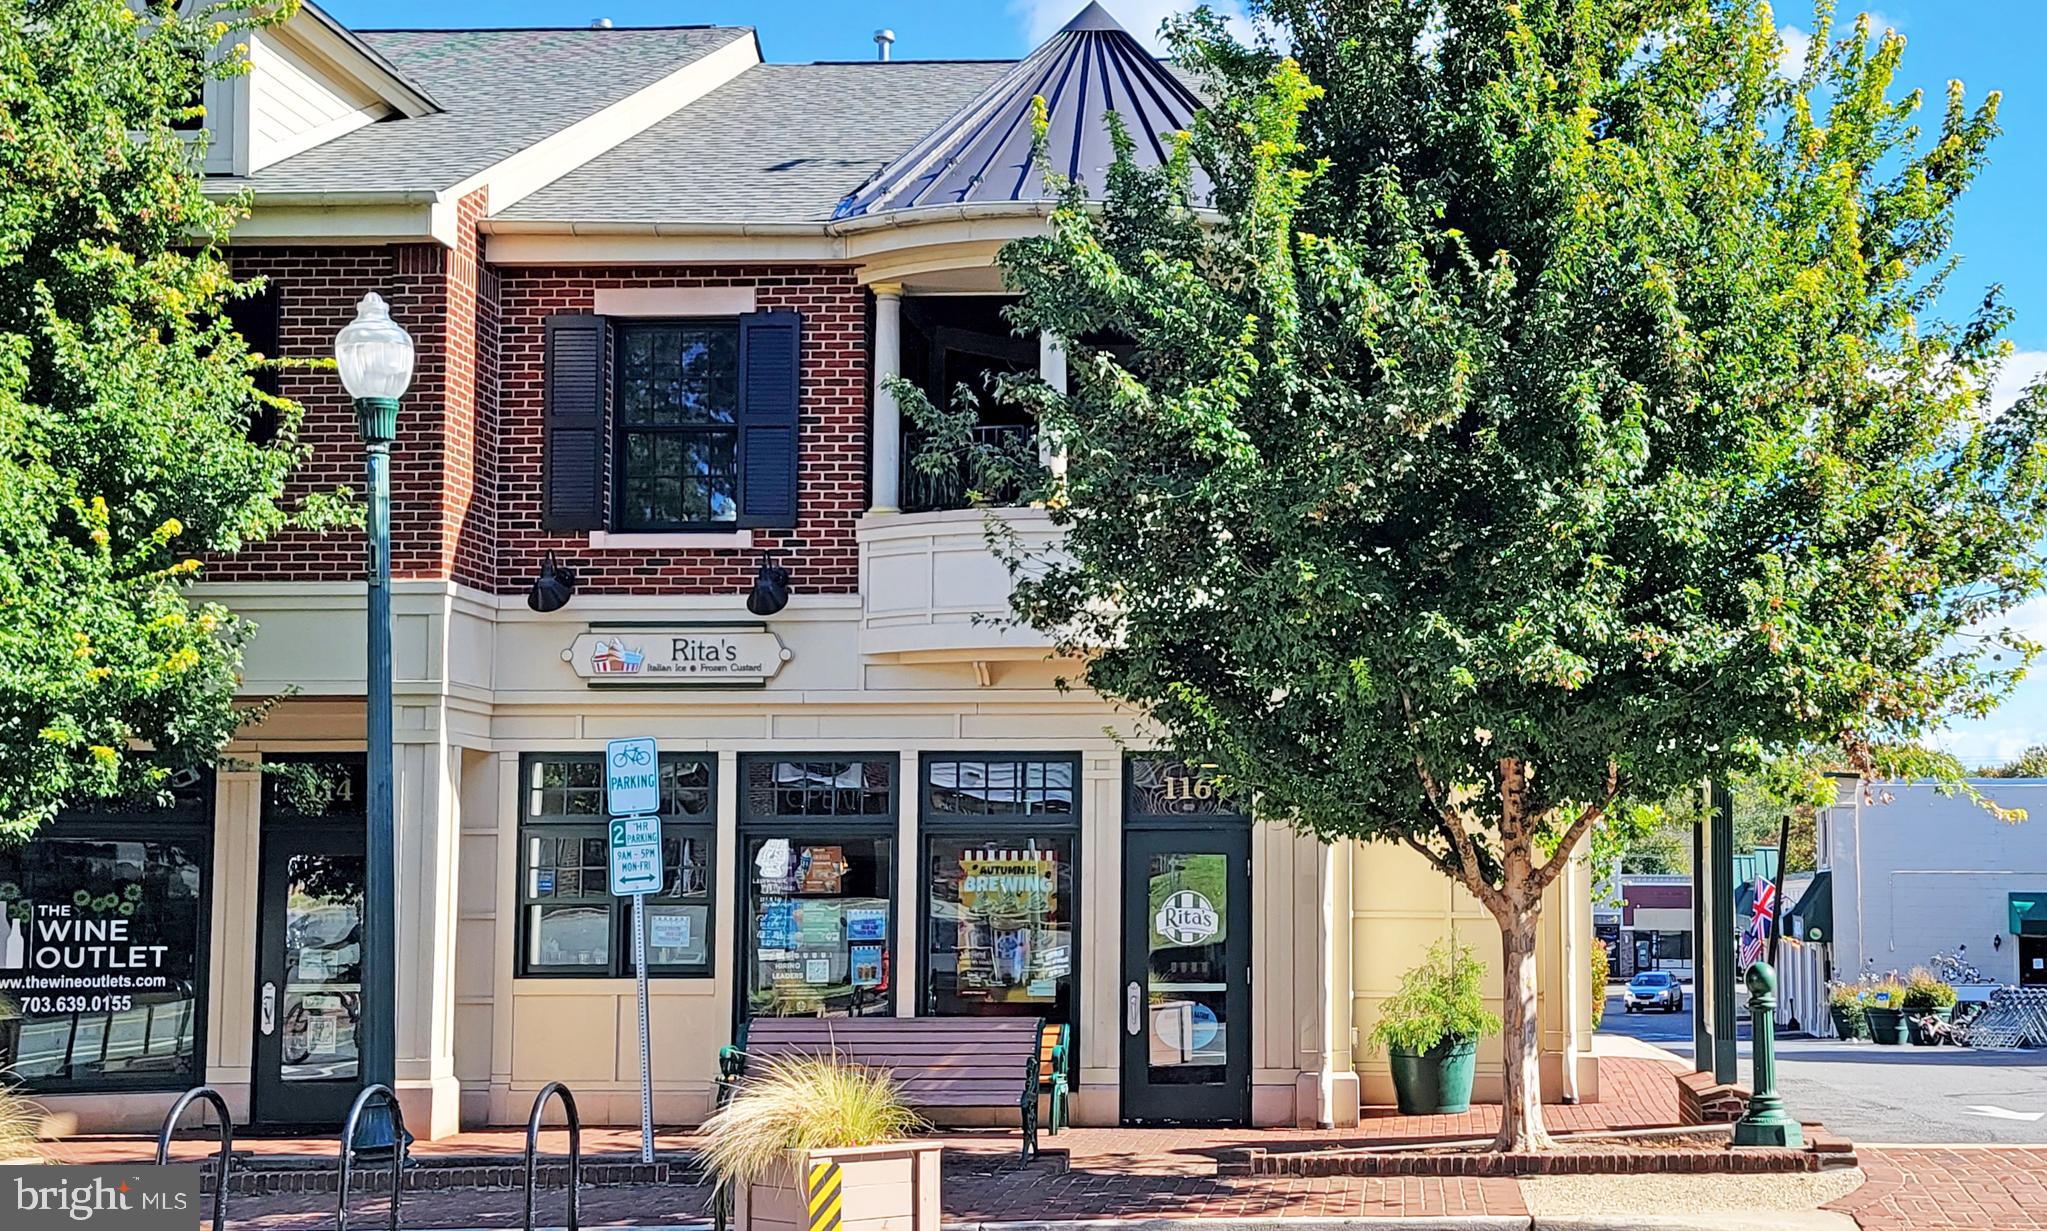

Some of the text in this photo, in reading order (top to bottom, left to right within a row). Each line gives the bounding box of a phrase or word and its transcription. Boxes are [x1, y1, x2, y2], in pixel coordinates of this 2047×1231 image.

[671, 638, 737, 661] Rita's
[647, 663, 762, 672] Italian Ice Frozen Custard
[611, 774, 655, 790] PARKING
[1164, 776, 1212, 800] 116
[613, 825, 624, 844] 2
[636, 821, 649, 832] HR
[627, 832, 657, 844] PARKING
[617, 849, 632, 861] 9AM
[640, 848, 656, 859] 5PM
[622, 860, 651, 872] MON-FRI
[979, 865, 1037, 875] AUTUMN IS
[963, 875, 1054, 892] BREWING
[38, 905, 71, 917] THE
[1165, 907, 1212, 928] Rita's
[38, 919, 129, 942] WINE
[36, 946, 168, 969] OUTLET
[20, 995, 132, 1012] 703.639.0155
